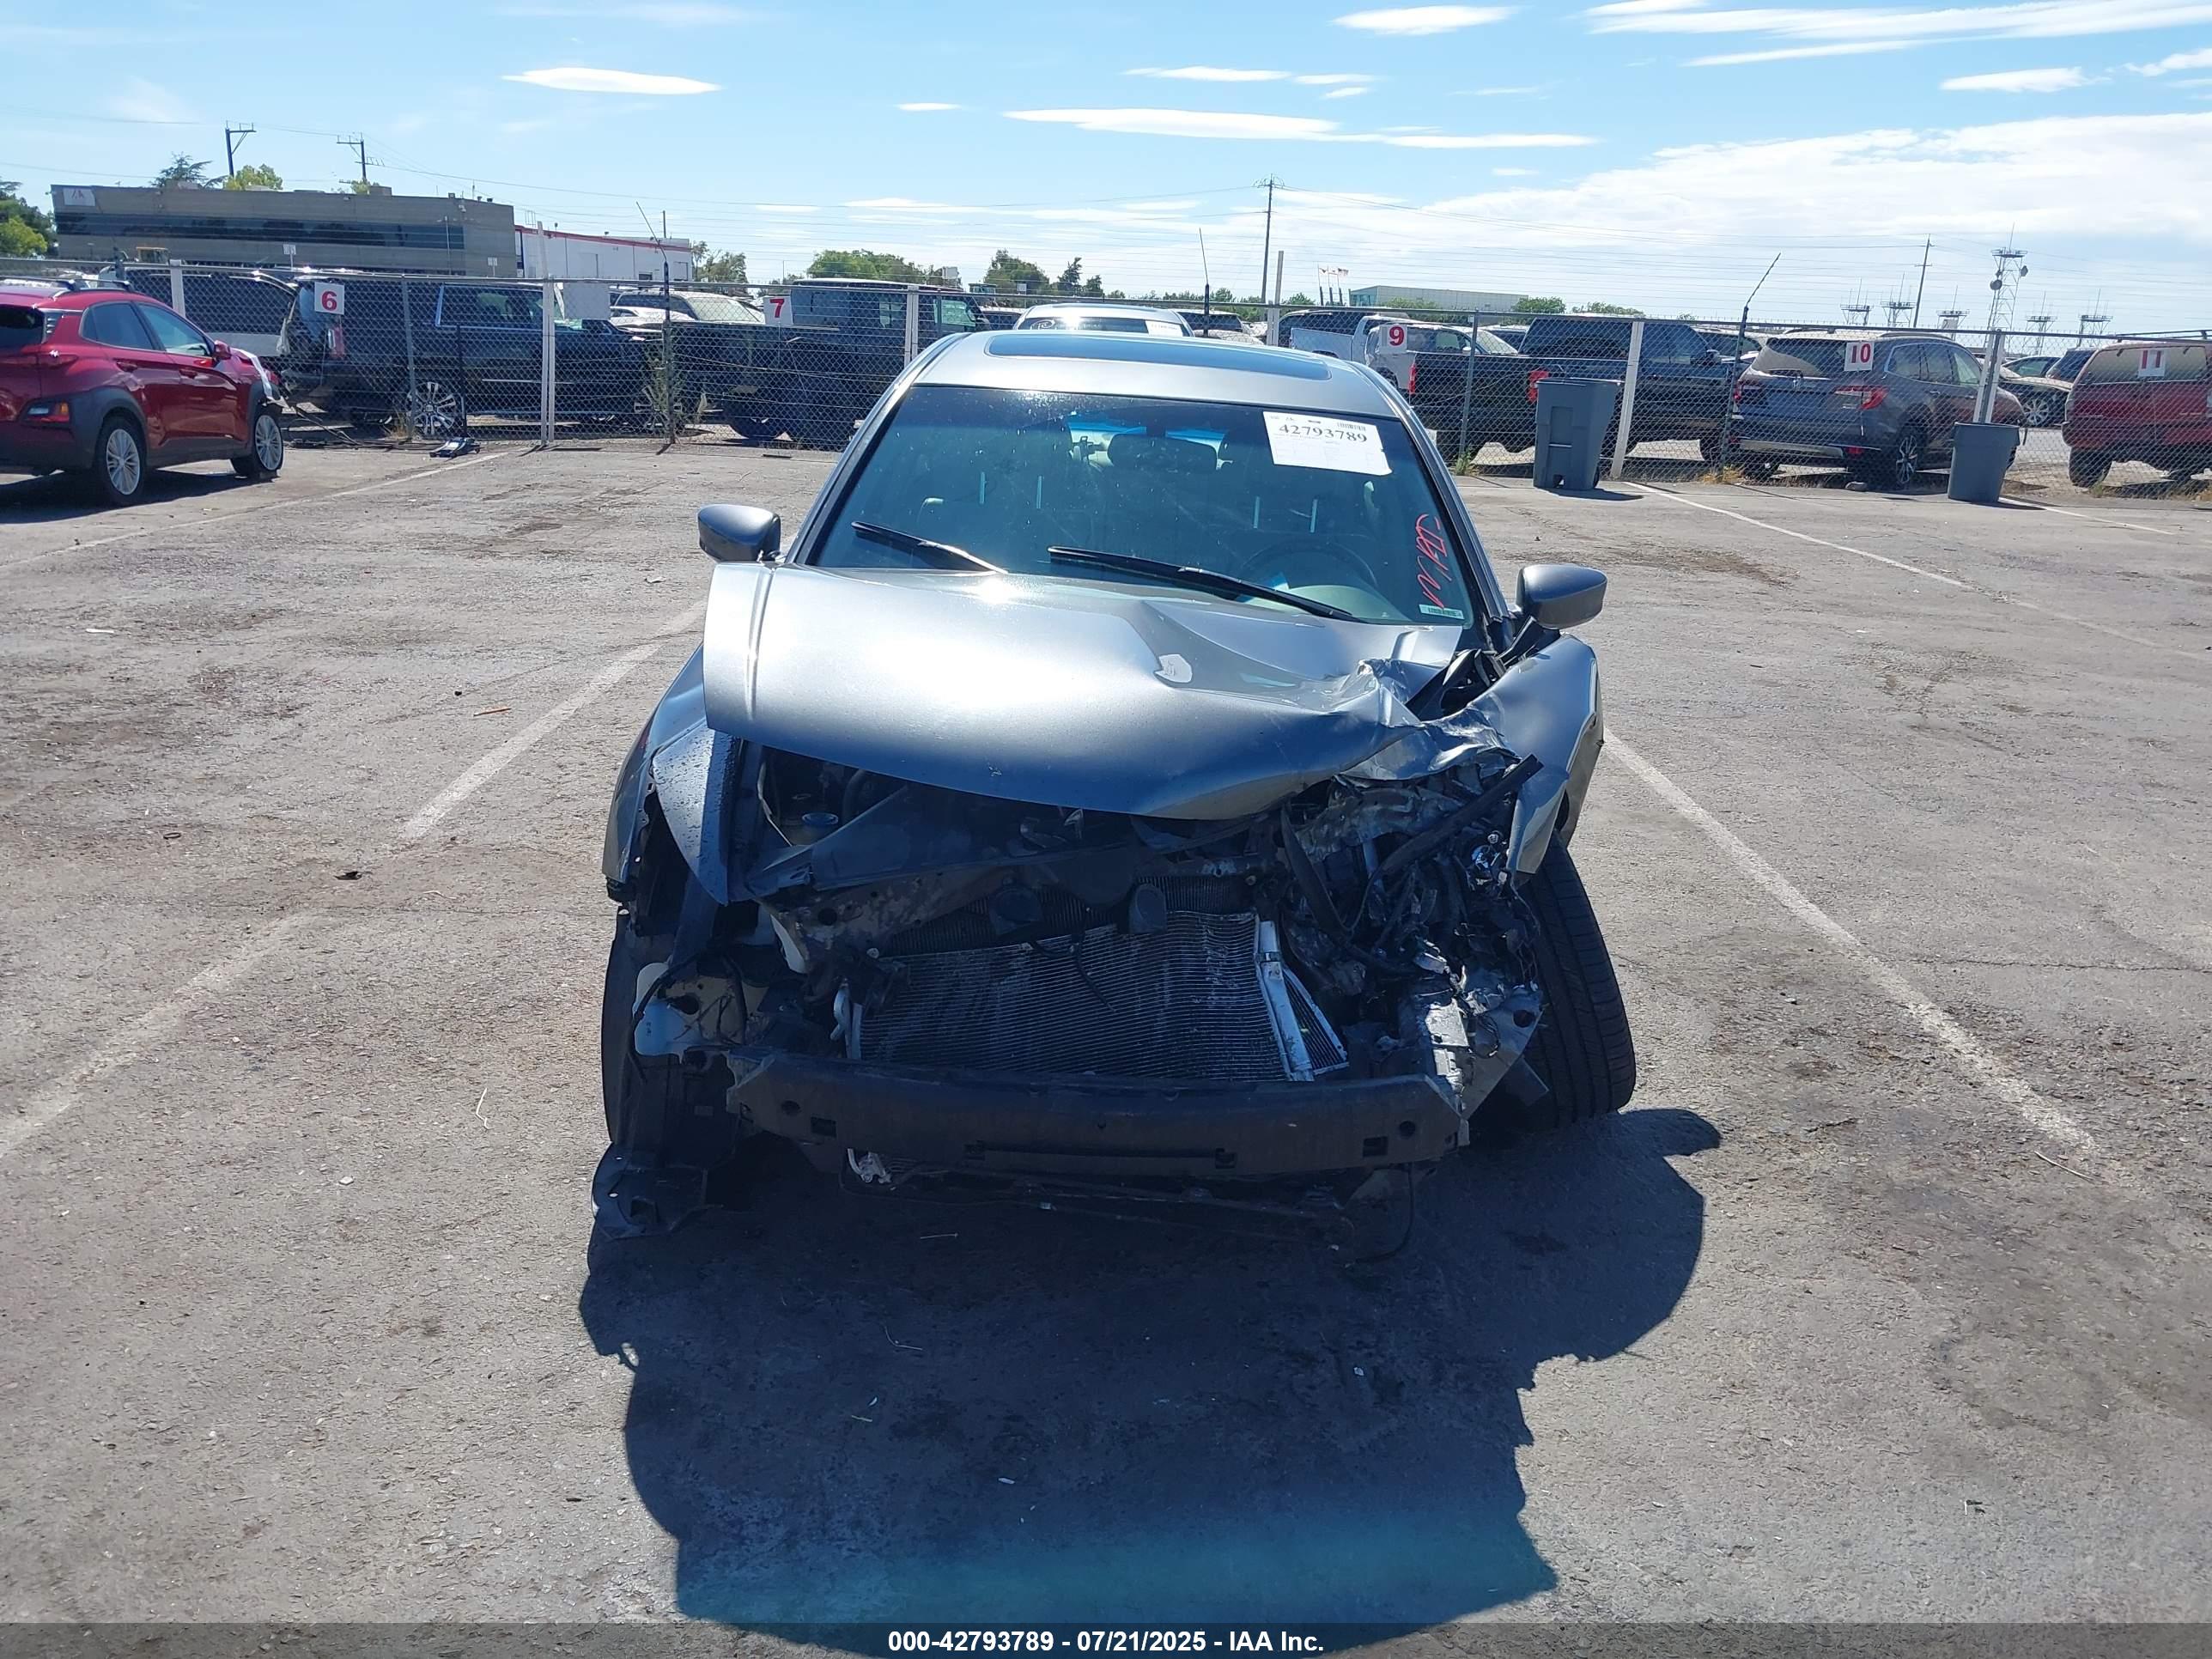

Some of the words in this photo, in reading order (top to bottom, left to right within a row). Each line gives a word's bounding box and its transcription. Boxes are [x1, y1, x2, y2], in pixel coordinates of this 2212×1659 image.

[322, 290, 337, 312] 6
[769, 298, 785, 319] 7
[1389, 325, 1405, 346] 9
[1851, 343, 1871, 363] 10
[2141, 349, 2162, 369] 11
[1279, 423, 1368, 443] 42793789
